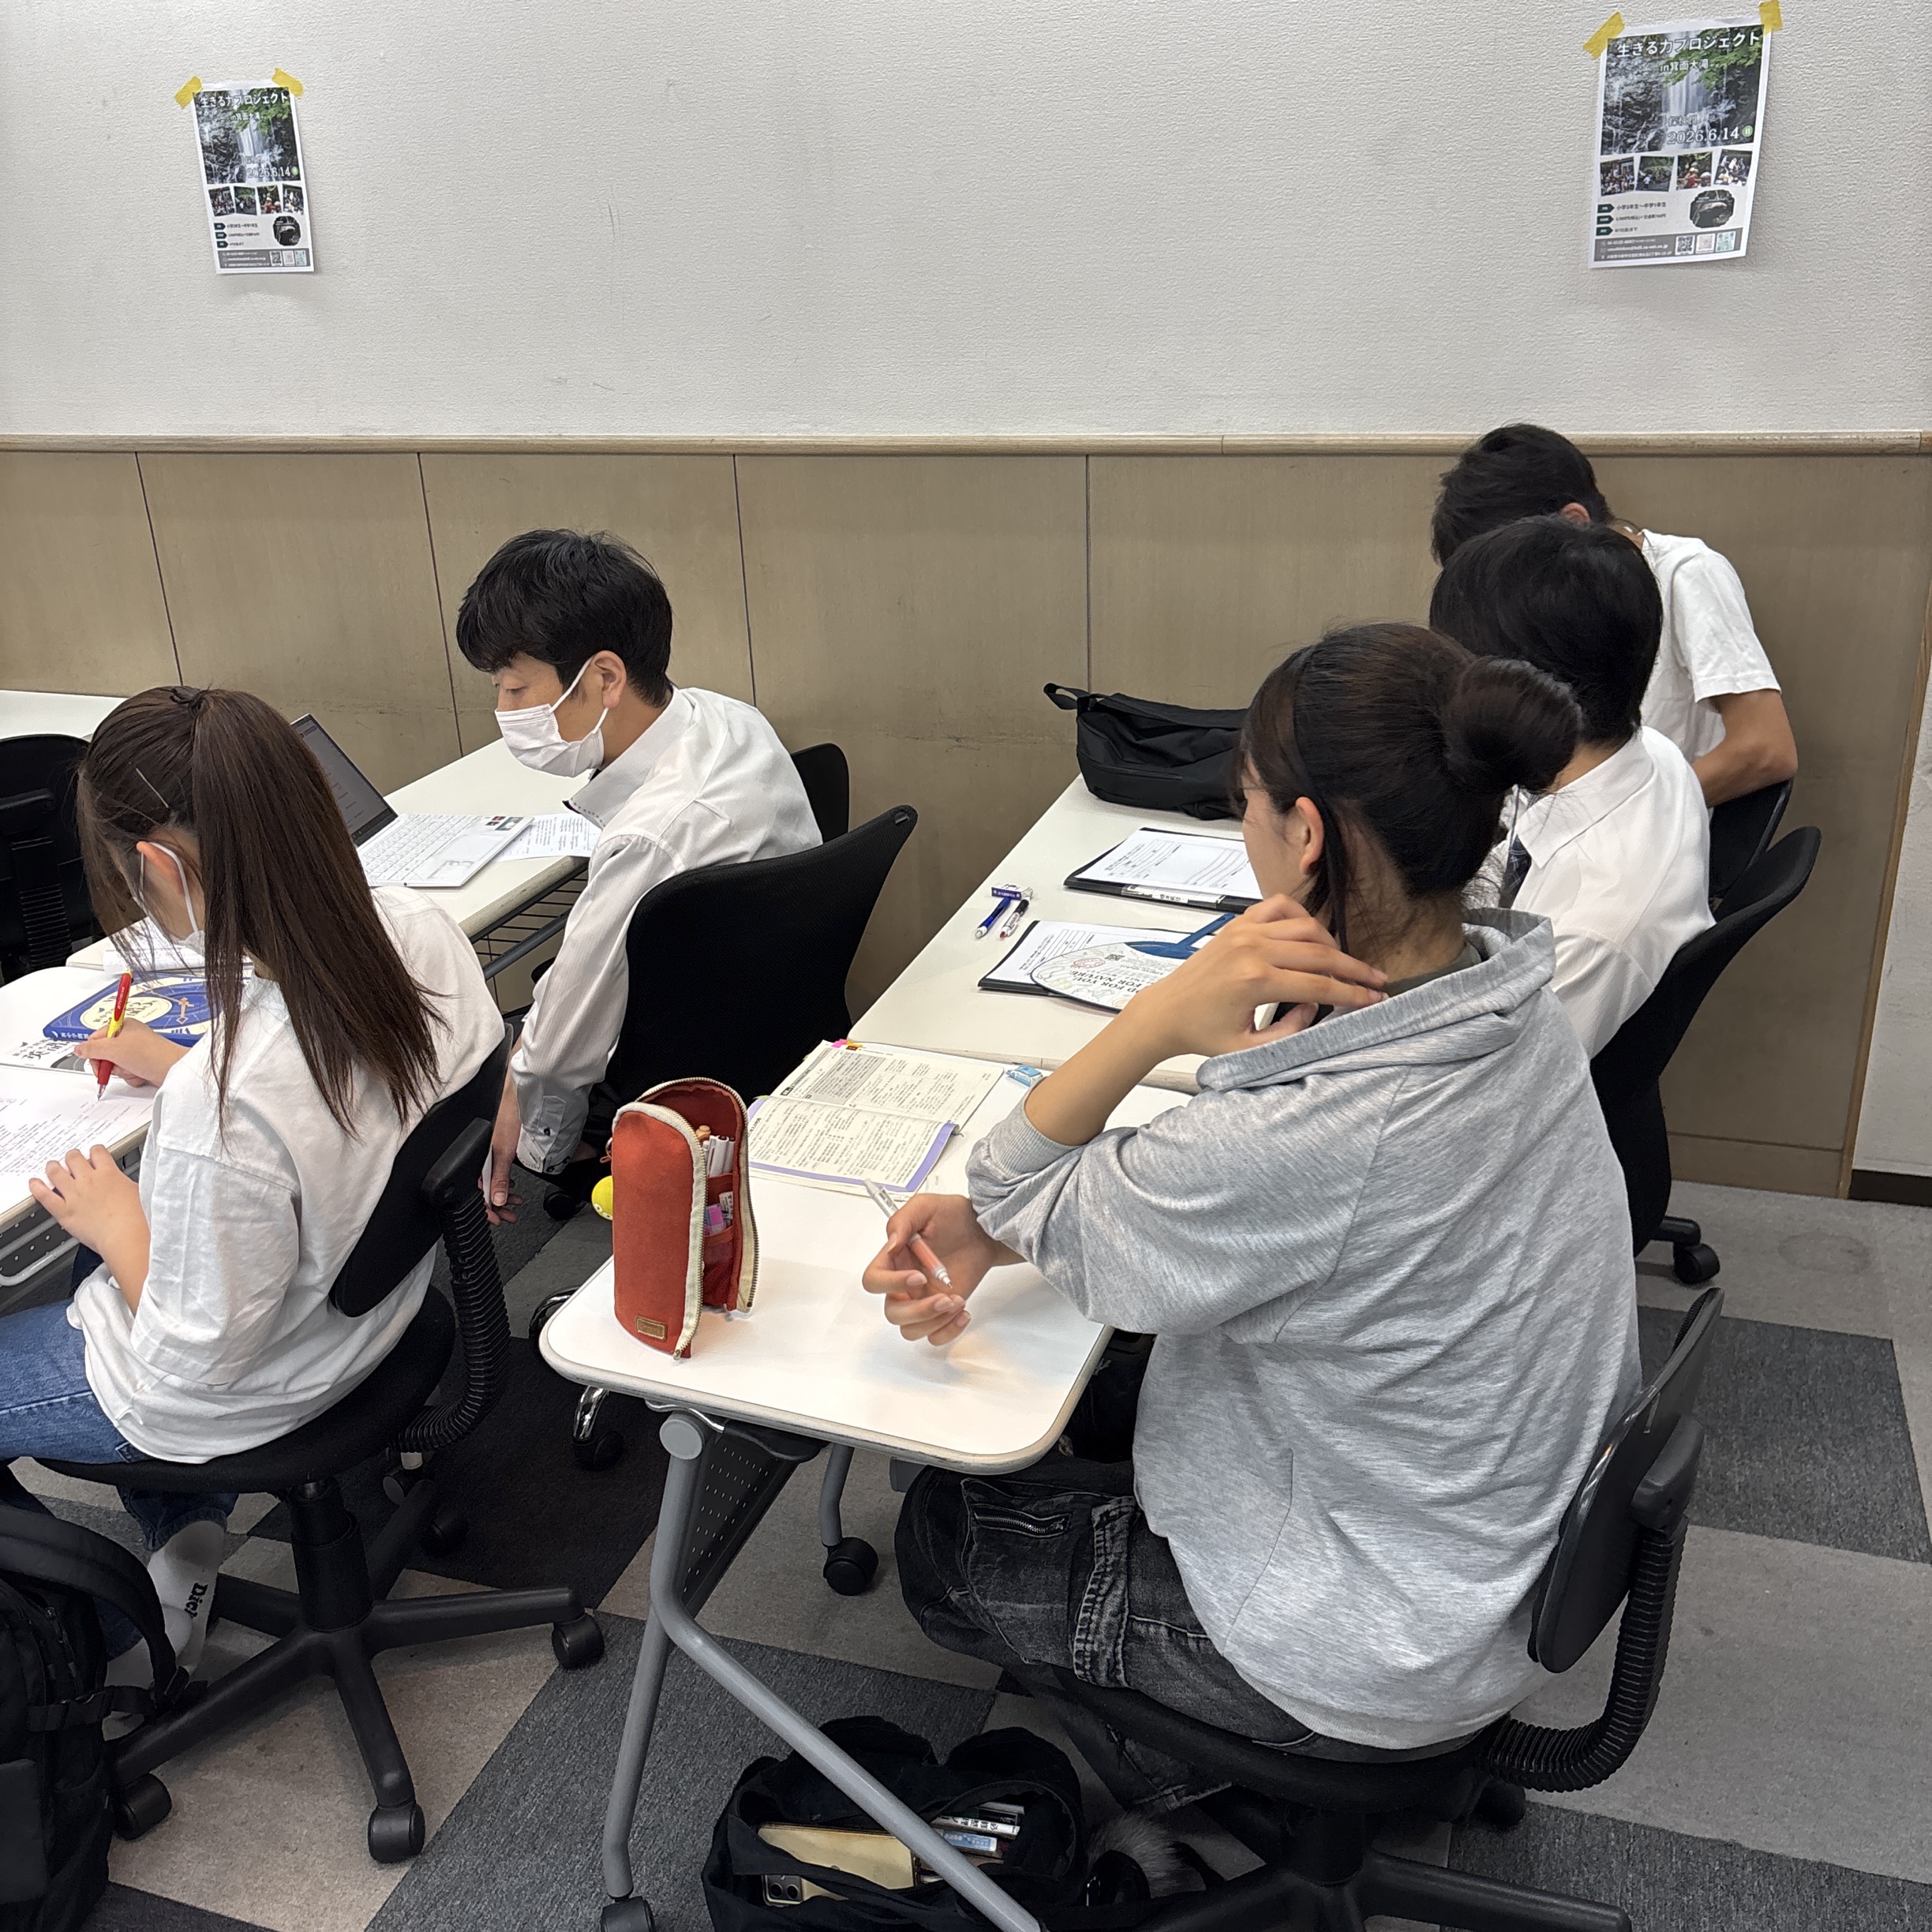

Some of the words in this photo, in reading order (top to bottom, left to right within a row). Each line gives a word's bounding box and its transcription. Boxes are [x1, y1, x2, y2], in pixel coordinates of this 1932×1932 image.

[1616, 32, 1761, 58] 生きる力プロジェクト
[1667, 126, 1739, 144] 2026.6.14
[1101, 981, 1125, 990] FOR
